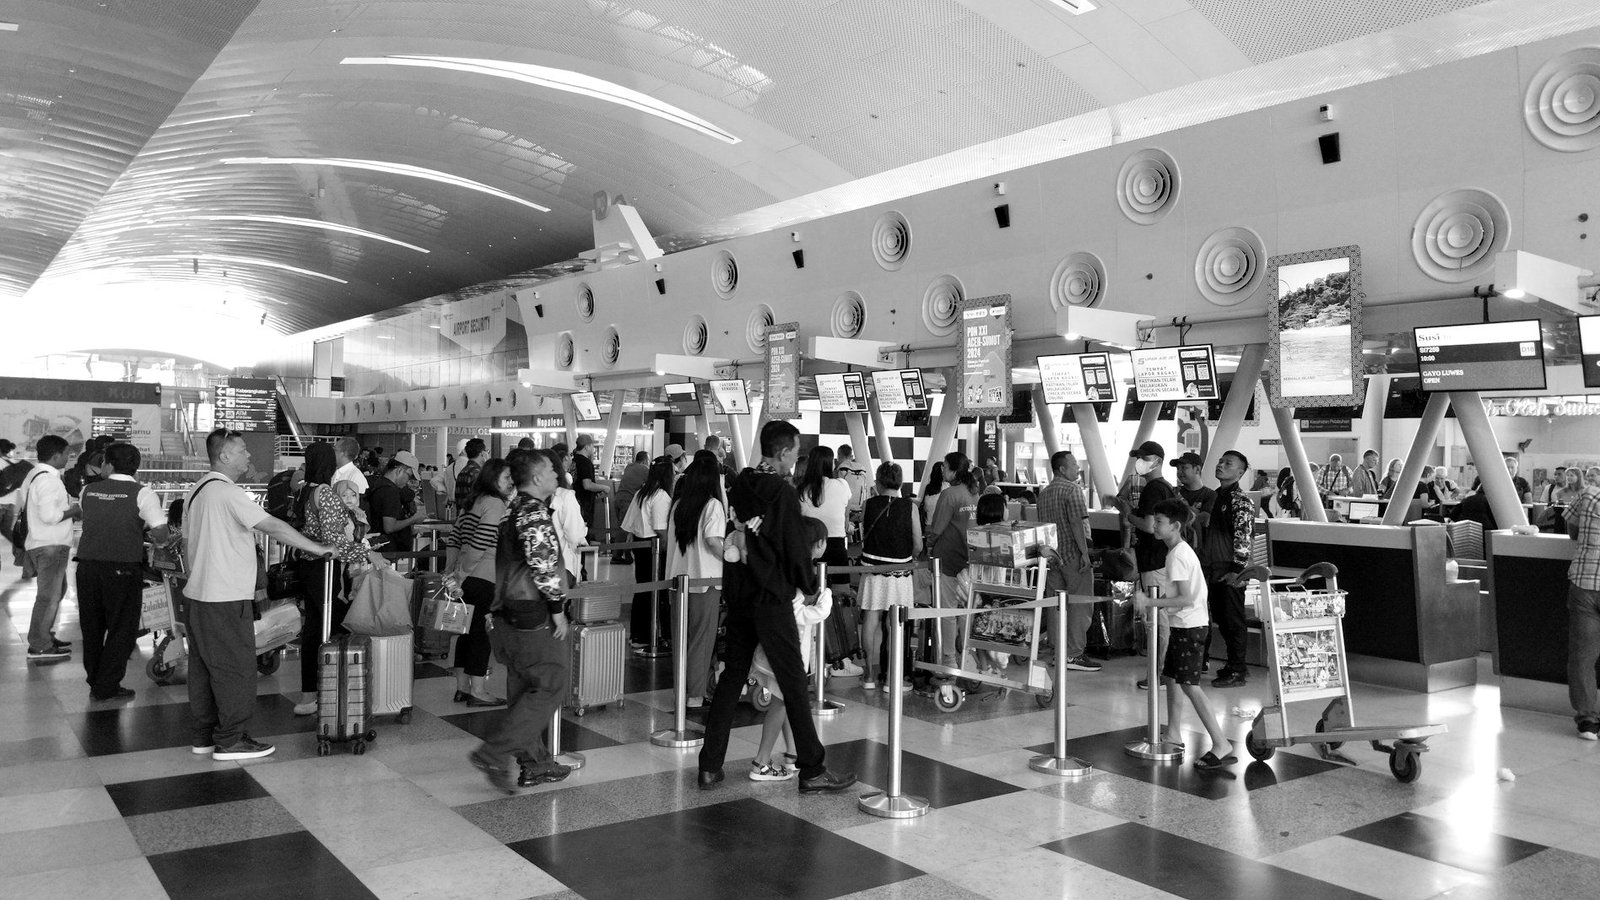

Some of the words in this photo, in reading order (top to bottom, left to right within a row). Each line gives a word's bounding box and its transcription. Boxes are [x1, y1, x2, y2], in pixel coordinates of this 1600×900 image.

[471, 316, 490, 333] SECURITY
[1418, 333, 1440, 341] Susi
[968, 347, 980, 358] 2024
